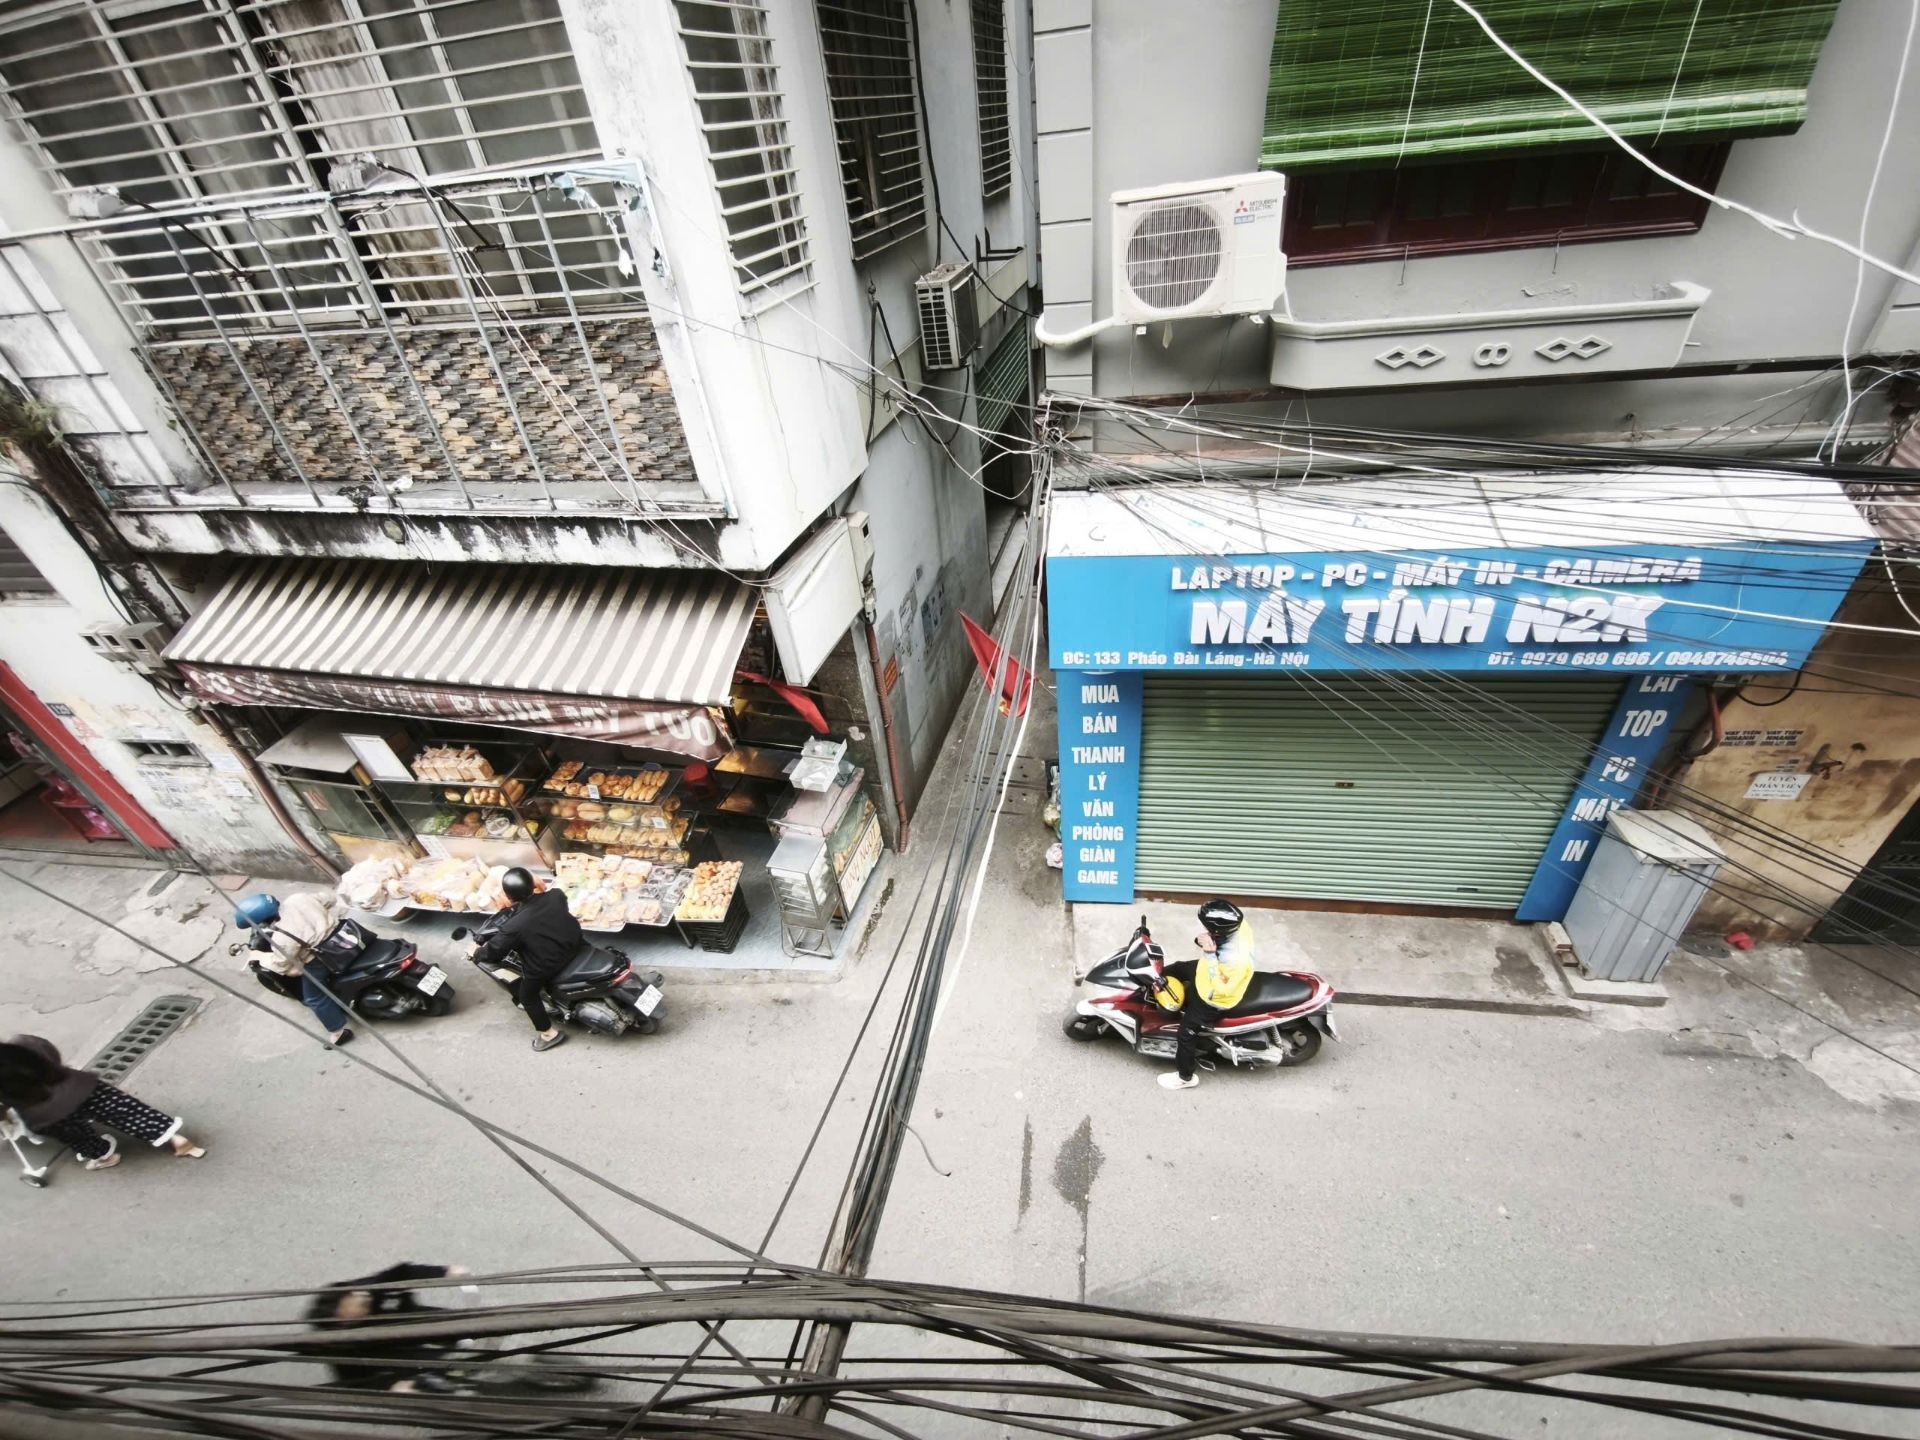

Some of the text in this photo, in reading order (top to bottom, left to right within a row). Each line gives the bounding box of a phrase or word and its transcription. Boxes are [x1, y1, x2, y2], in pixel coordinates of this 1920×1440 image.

[1171, 566, 1296, 591] LAPTOP
[1321, 563, 1367, 588] PC
[1391, 556, 1468, 587] MÁY
[1474, 560, 1517, 585] IN
[1543, 556, 1703, 584] CAMERA
[1190, 588, 1667, 644] MÁY TÍNH N2K
[1063, 652, 1090, 666] ĐC:
[1093, 652, 1121, 666] 133
[1127, 651, 1168, 666] Pháo
[1173, 651, 1200, 666] Đài
[1280, 651, 1310, 667] Nội
[1520, 652, 1568, 666] 0979
[1572, 652, 1606, 666] 689
[1081, 684, 1120, 704] MUA
[1082, 711, 1117, 734] BÁN
[1619, 709, 1668, 737] TOP
[1071, 746, 1125, 764] THANH
[1599, 756, 1637, 783] PC
[1088, 771, 1108, 791] LÝ
[1082, 799, 1115, 817] VĂN
[1072, 822, 1124, 841] PHÒNG
[1079, 844, 1116, 863] GIÀN
[1560, 840, 1590, 862] IN
[1077, 869, 1119, 885] GAME
